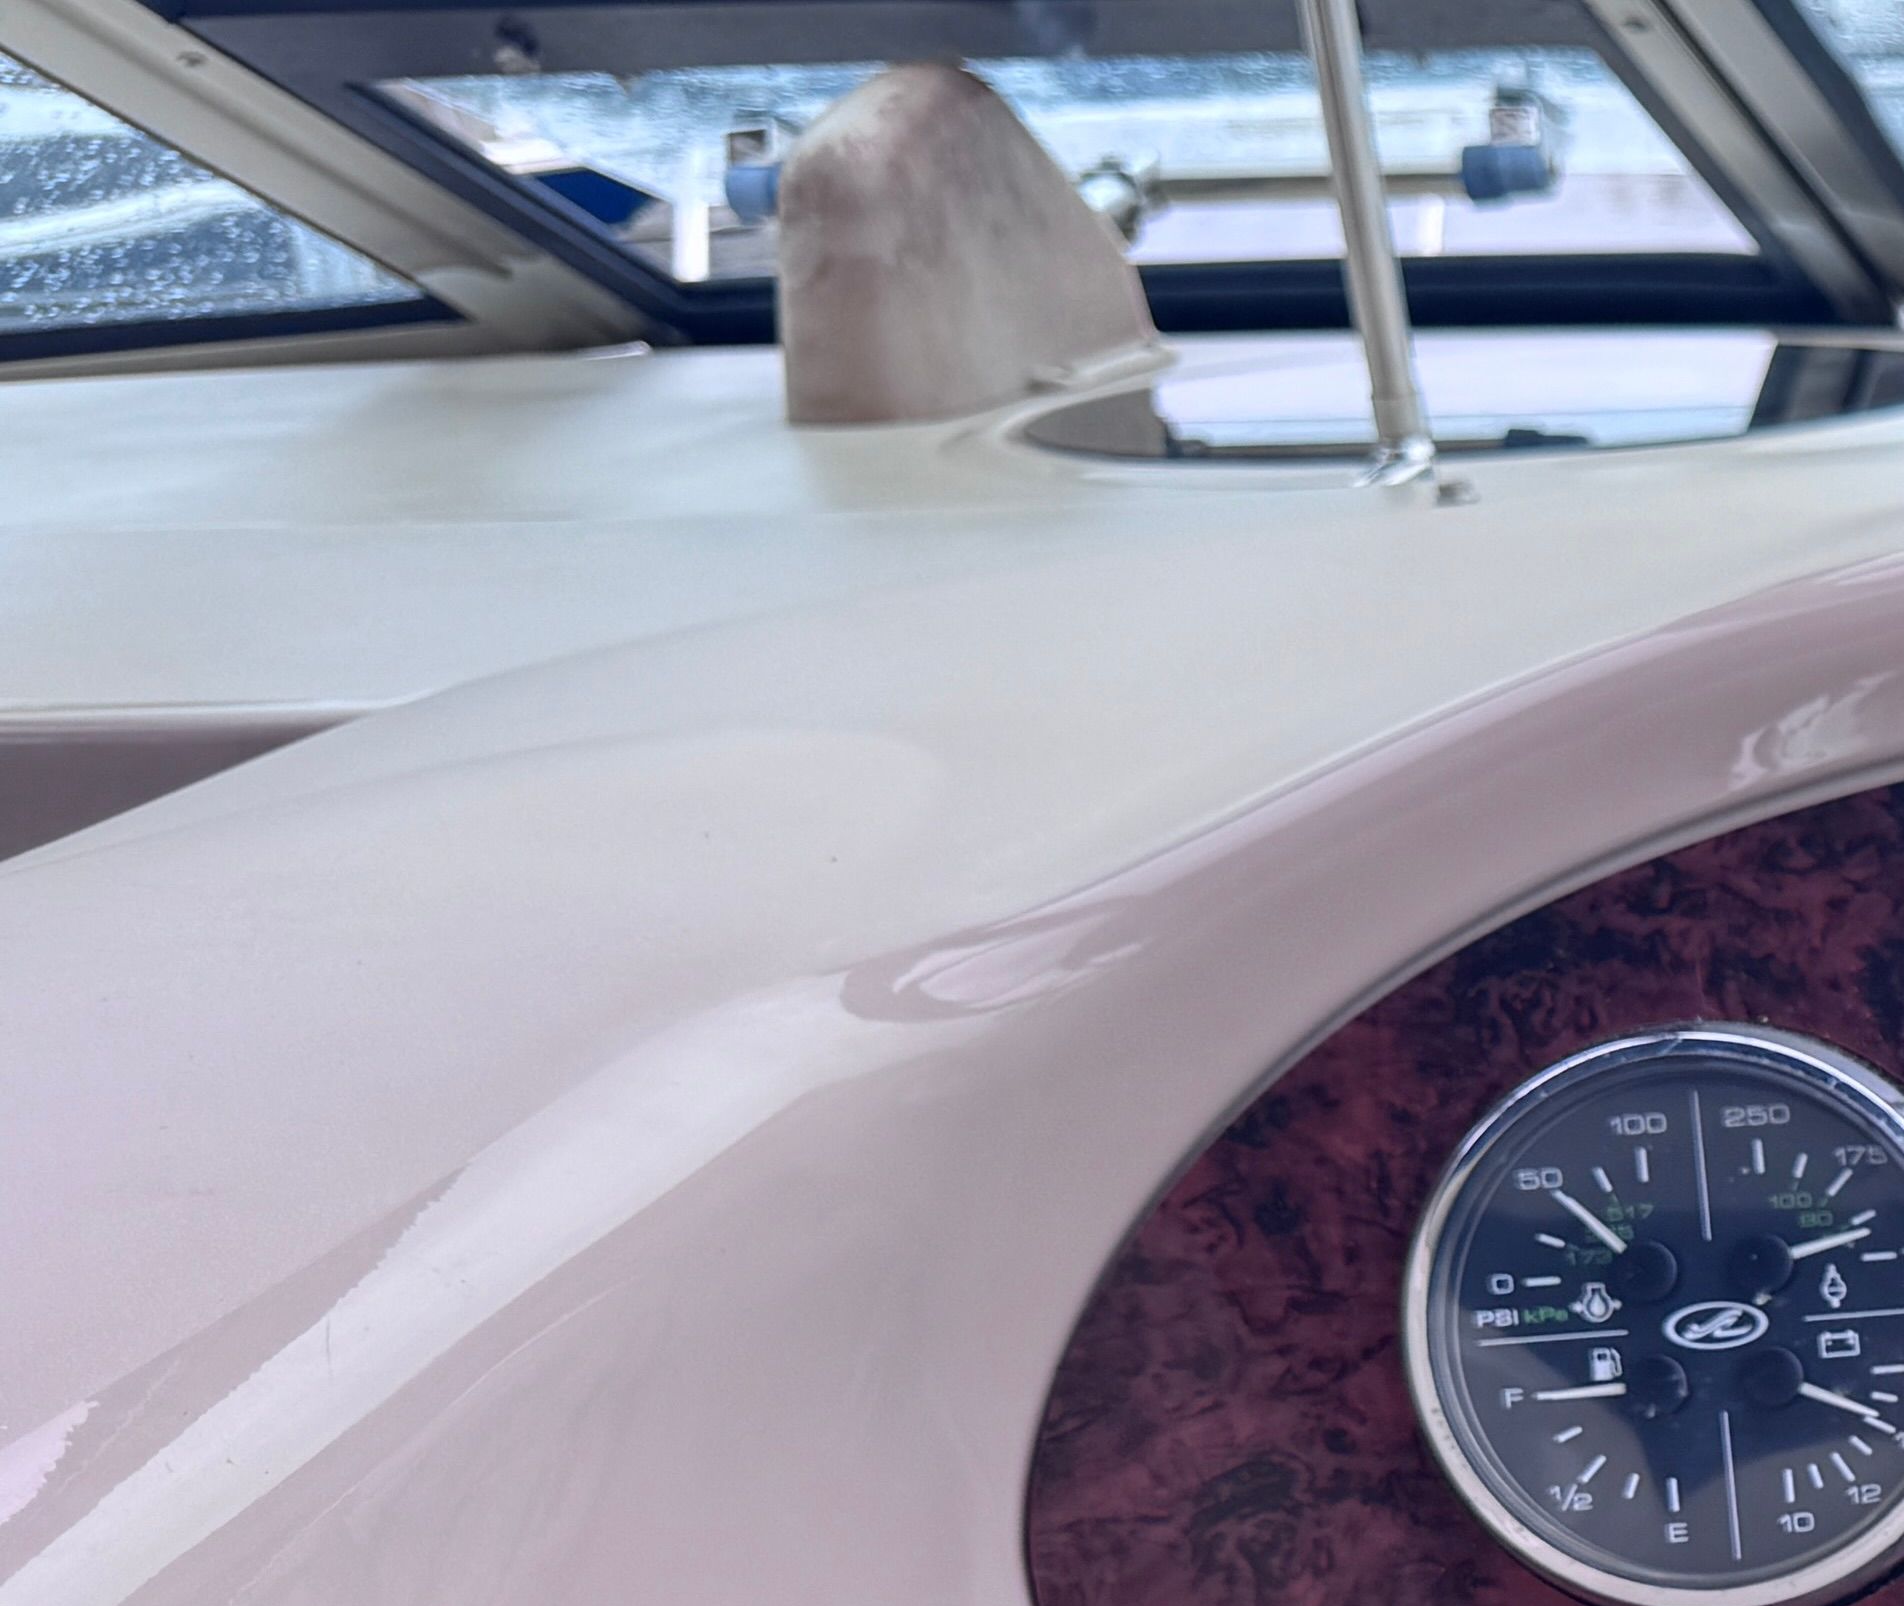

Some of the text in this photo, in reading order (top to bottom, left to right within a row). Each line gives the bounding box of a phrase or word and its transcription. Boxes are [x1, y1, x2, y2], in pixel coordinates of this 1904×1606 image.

[1610, 1114, 1667, 1136] 100
[1724, 1105, 1791, 1129] 250
[1834, 1146, 1887, 1168] 175
[1515, 1170, 1564, 1190] 50
[1768, 1191, 1814, 1210] 100
[1490, 1274, 1515, 1295] 0
[1476, 1309, 1520, 1327] PSI
[1504, 1387, 1523, 1408] F
[1846, 1484, 1883, 1506] 12
[1667, 1522, 1690, 1543] E
[1777, 1513, 1815, 1534] 10
